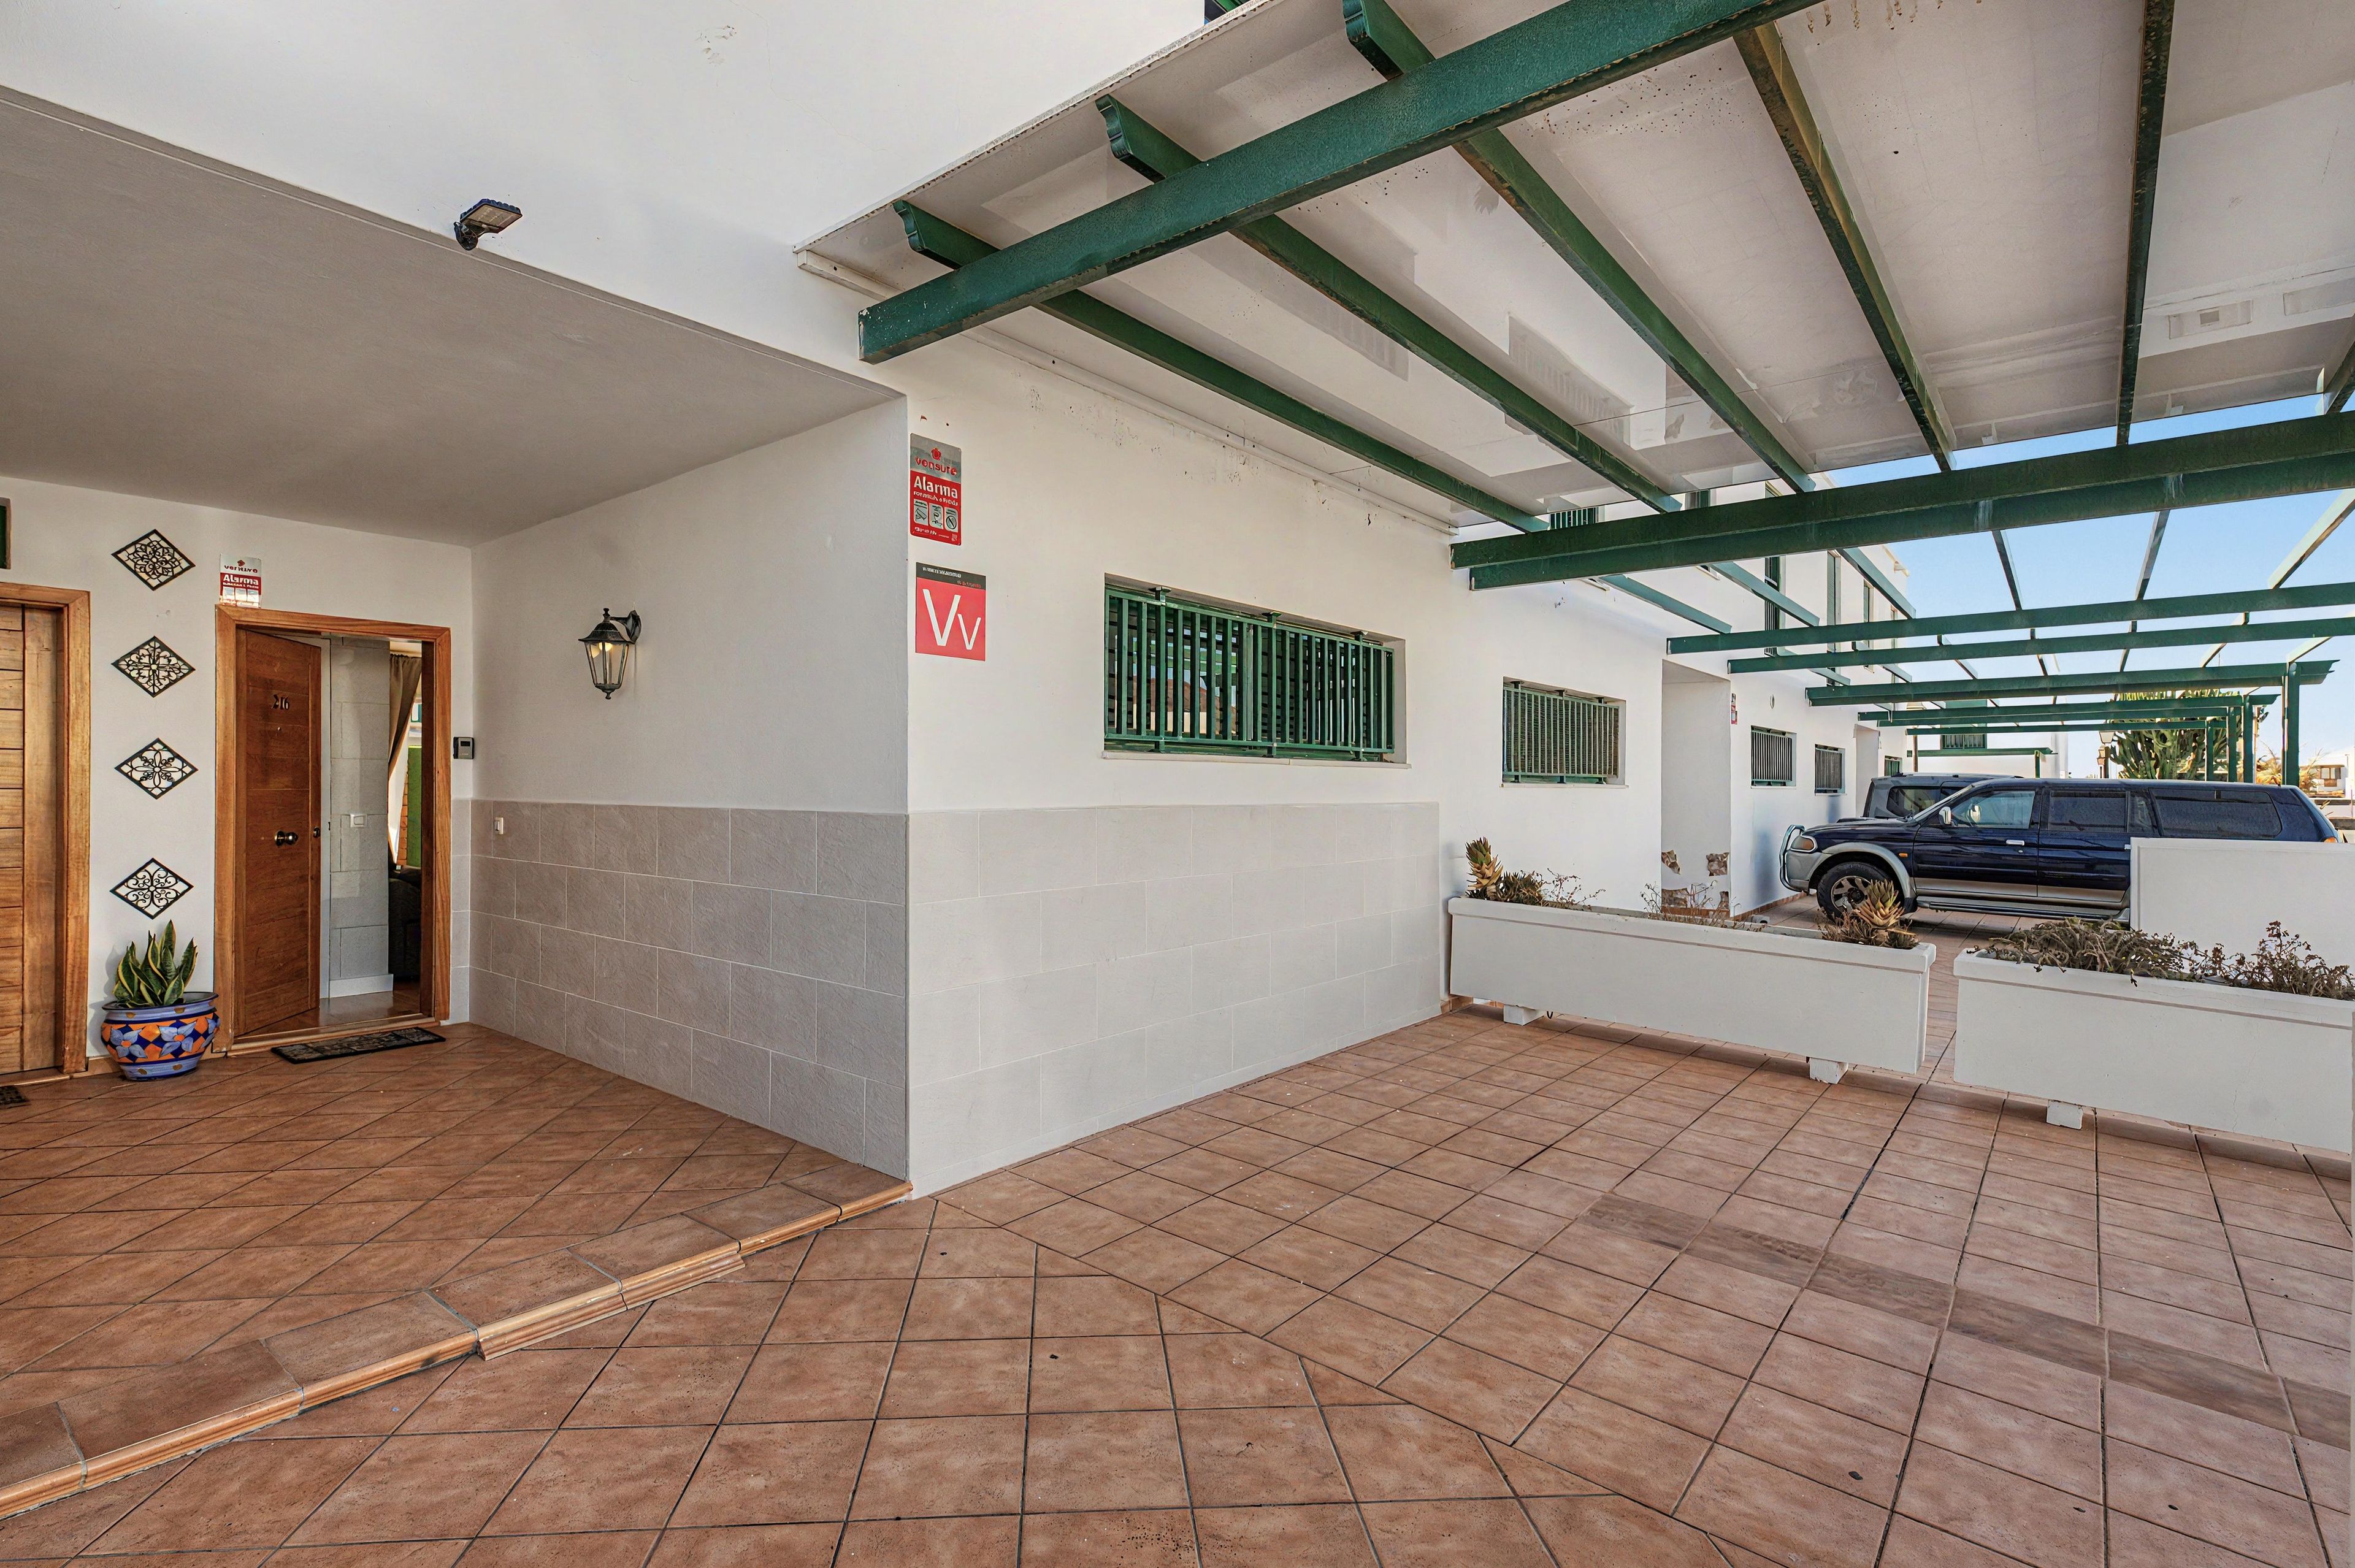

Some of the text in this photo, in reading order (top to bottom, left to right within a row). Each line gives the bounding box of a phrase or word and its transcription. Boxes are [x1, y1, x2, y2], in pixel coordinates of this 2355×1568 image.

[914, 475, 958, 499] Alarma
[223, 574, 259, 585] Alarma
[272, 694, 289, 710] 216
